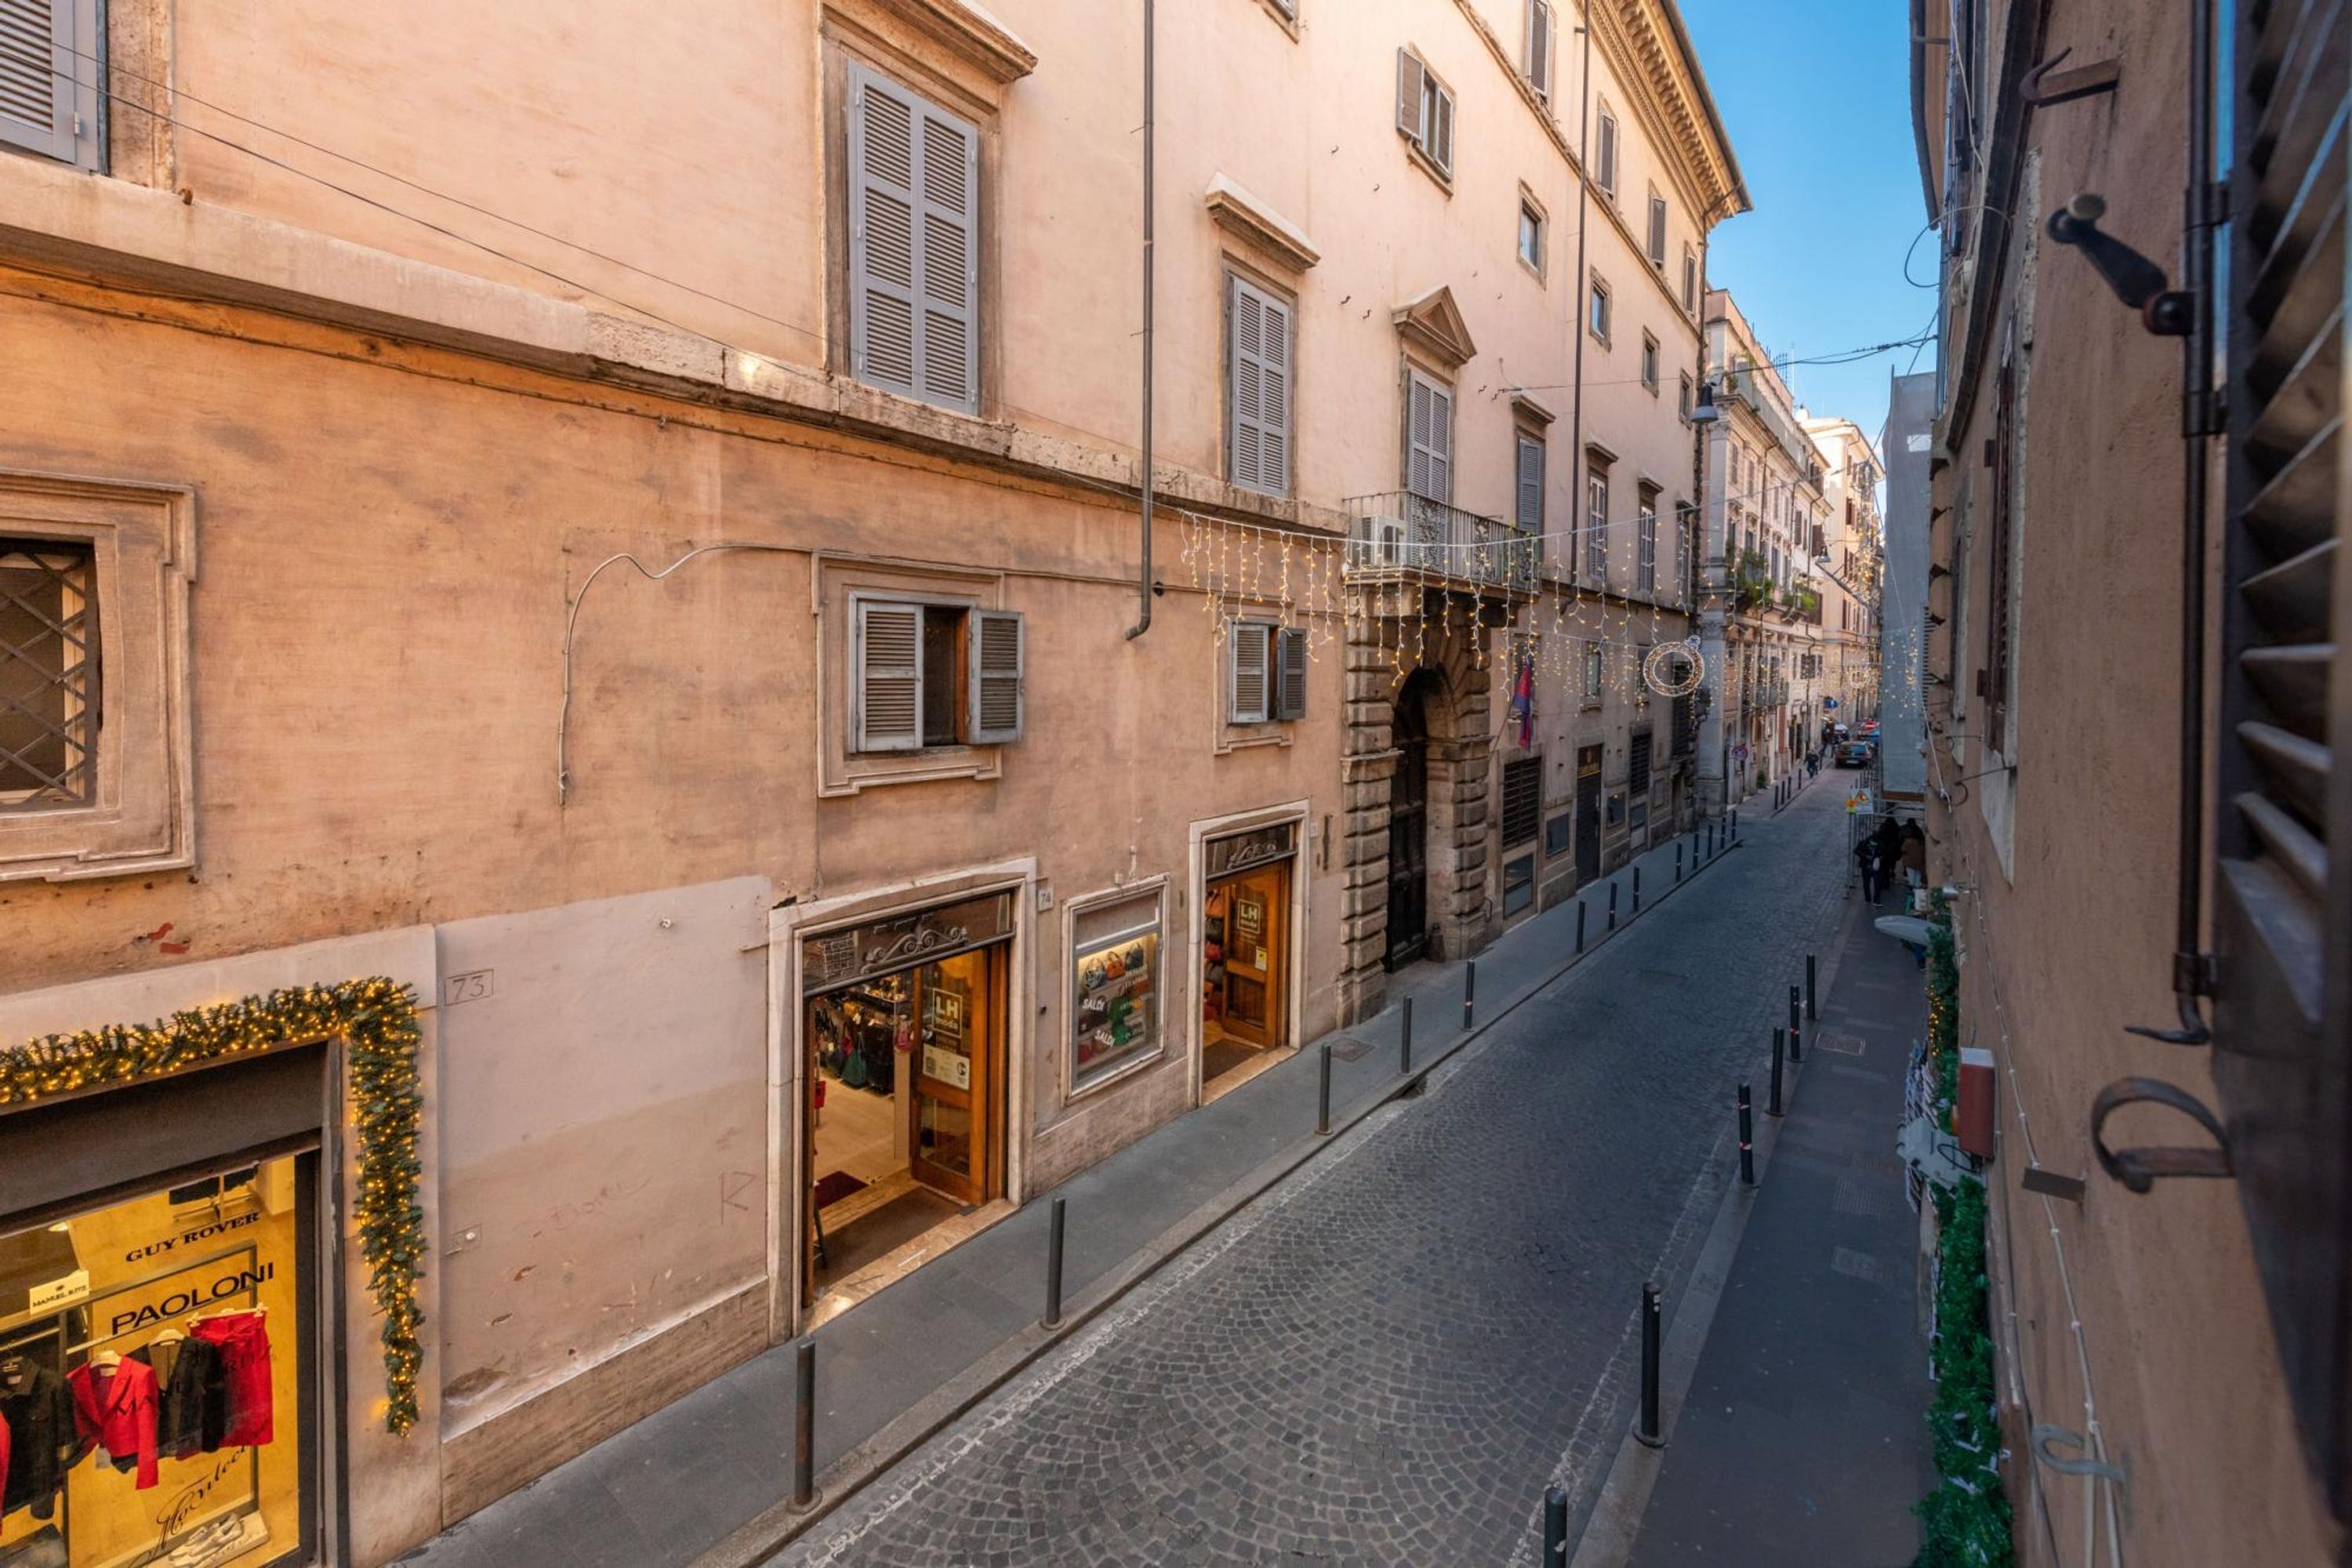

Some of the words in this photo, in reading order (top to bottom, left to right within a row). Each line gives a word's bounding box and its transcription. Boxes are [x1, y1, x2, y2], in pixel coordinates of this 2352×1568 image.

[1240, 904, 1258, 921] LH
[452, 975, 485, 1001] 73
[935, 995, 959, 1019] LH
[125, 1238, 176, 1262] GUY
[183, 1212, 260, 1245] ROVER
[112, 1261, 274, 1335] PAOLONI
